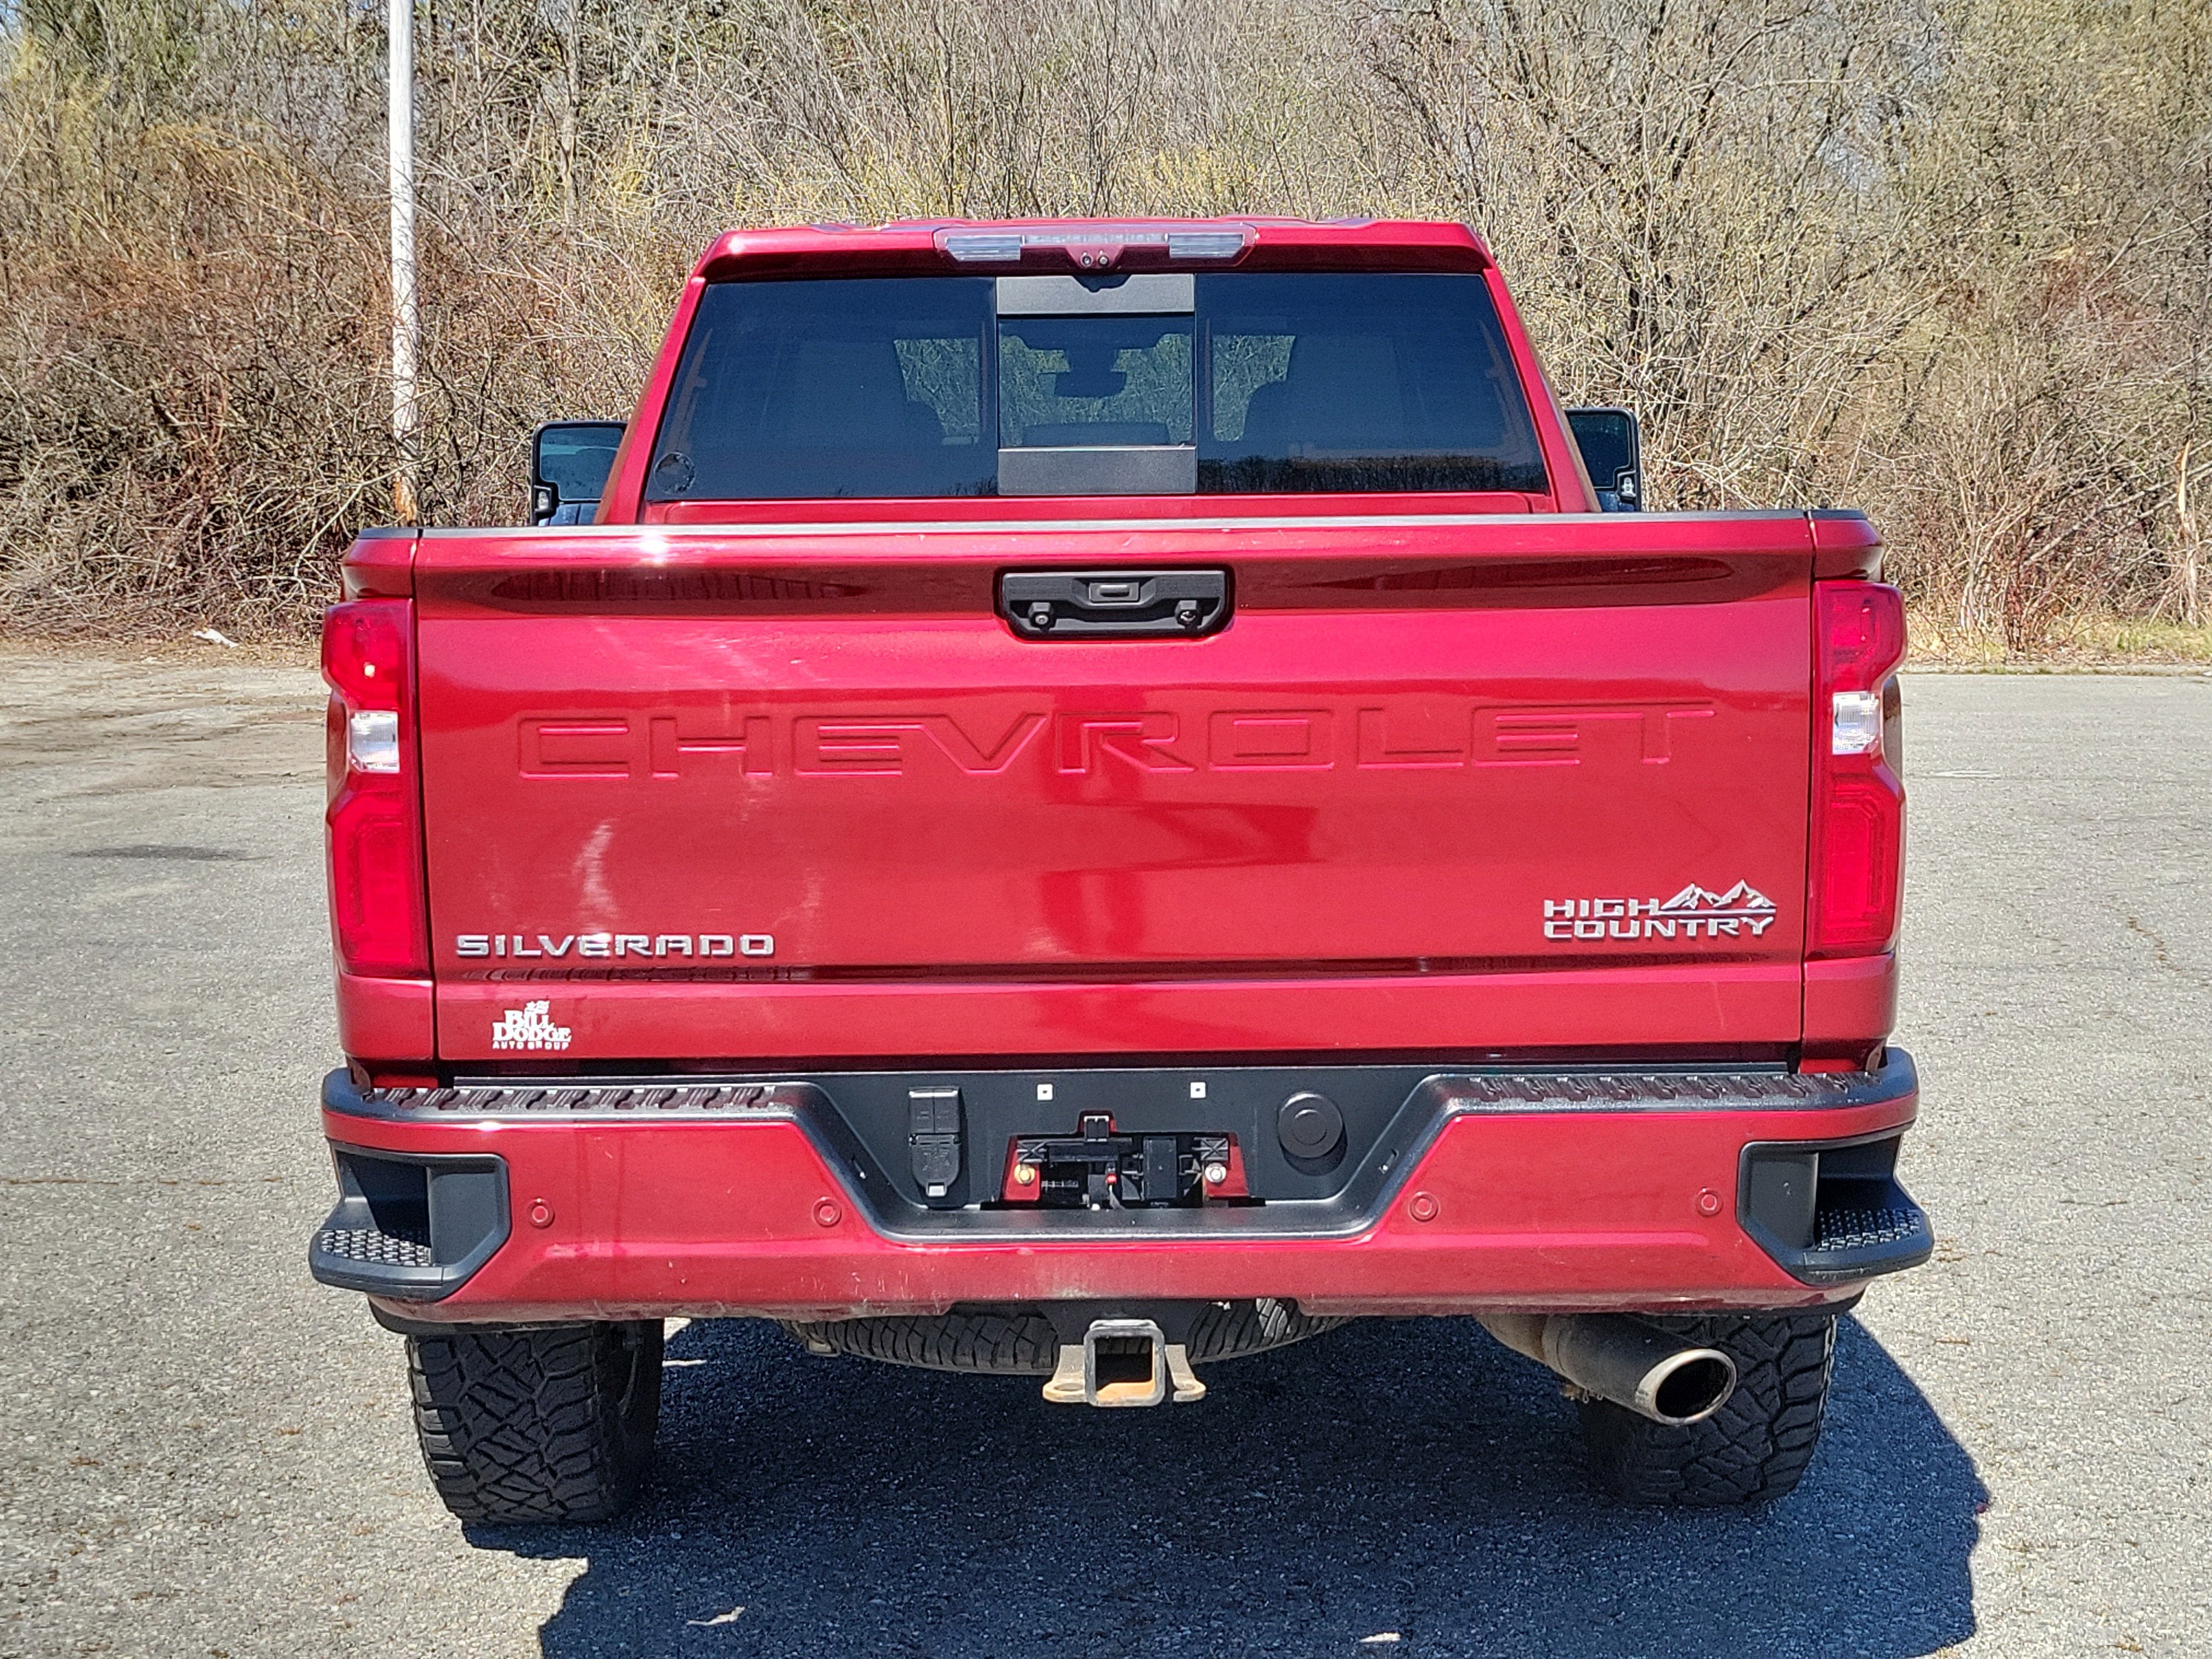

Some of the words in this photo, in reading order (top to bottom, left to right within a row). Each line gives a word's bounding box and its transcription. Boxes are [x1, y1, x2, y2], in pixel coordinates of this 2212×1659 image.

[517, 701, 1716, 777] CHEVROLET
[1544, 898, 1660, 918] HIGH
[1544, 917, 1774, 938] COUNTRY
[456, 934, 775, 957] SILVERADO
[504, 1010, 555, 1029] BILL
[493, 1022, 572, 1042] DODGE
[493, 1041, 524, 1050] AUTO
[527, 1041, 569, 1050] GROUP
